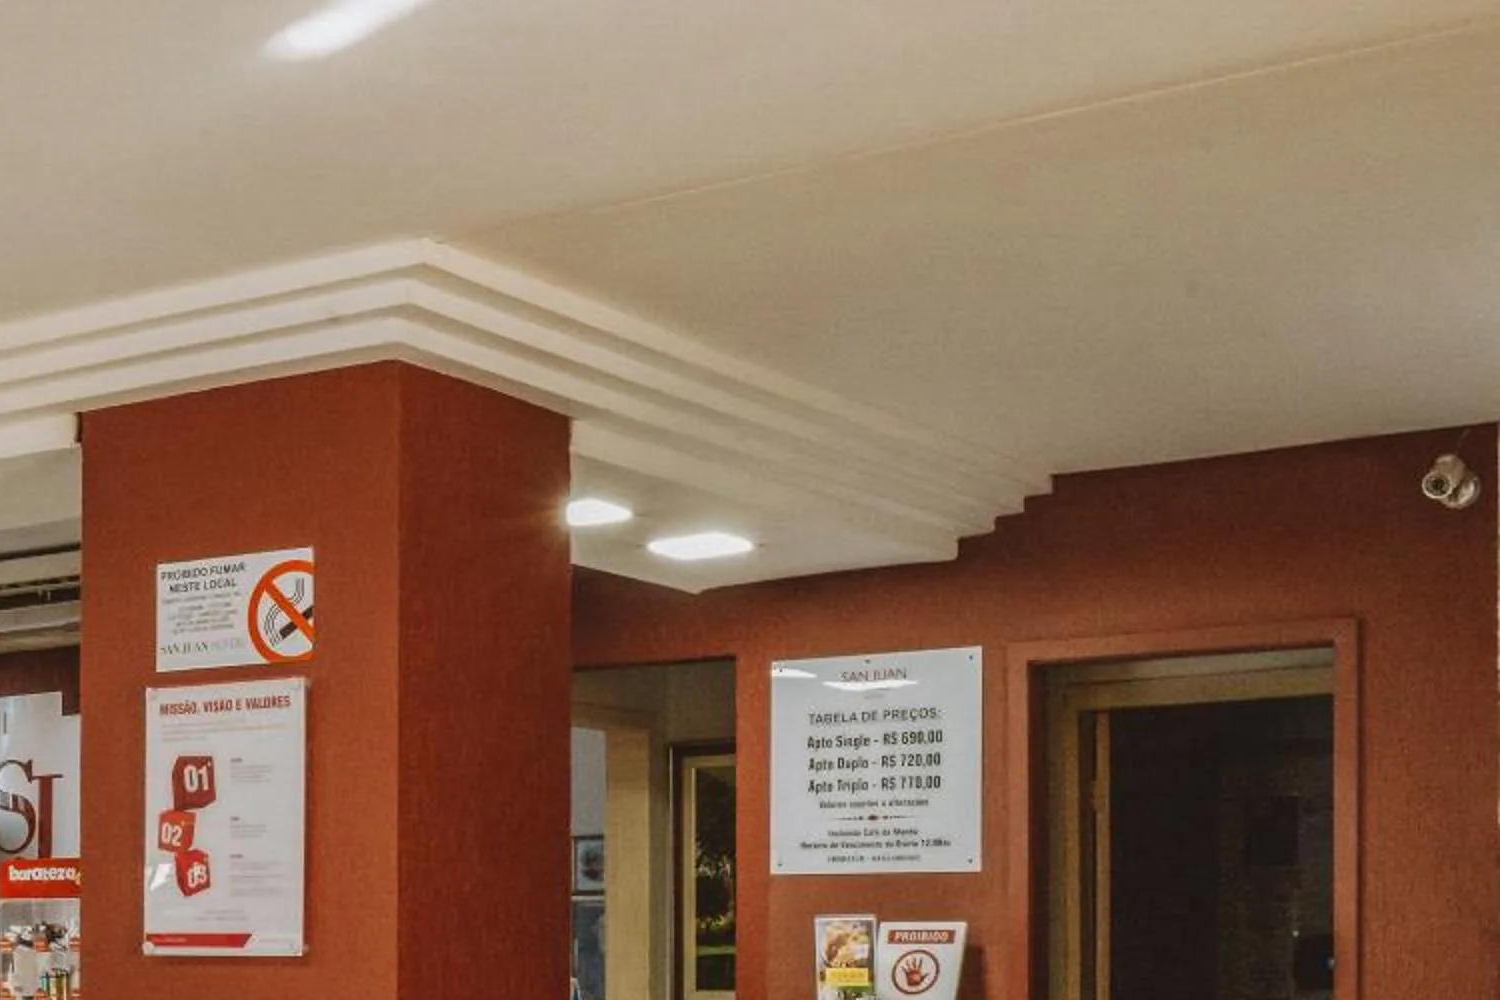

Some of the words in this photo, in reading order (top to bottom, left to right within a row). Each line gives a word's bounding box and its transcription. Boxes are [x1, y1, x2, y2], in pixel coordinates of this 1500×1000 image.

[161, 567, 208, 580] PROIBIDO
[209, 562, 245, 576] FUMAR
[169, 581, 201, 593] NESTE
[203, 578, 237, 590] LOCAL
[235, 699, 242, 711] E
[245, 695, 291, 710] VALORES
[808, 712, 857, 725] TABELA
[861, 711, 878, 723] DE
[835, 735, 871, 750] Single
[184, 764, 209, 793] 01
[161, 822, 182, 847] 02
[187, 861, 208, 888] 03
[893, 930, 950, 943] PROIBIDO
